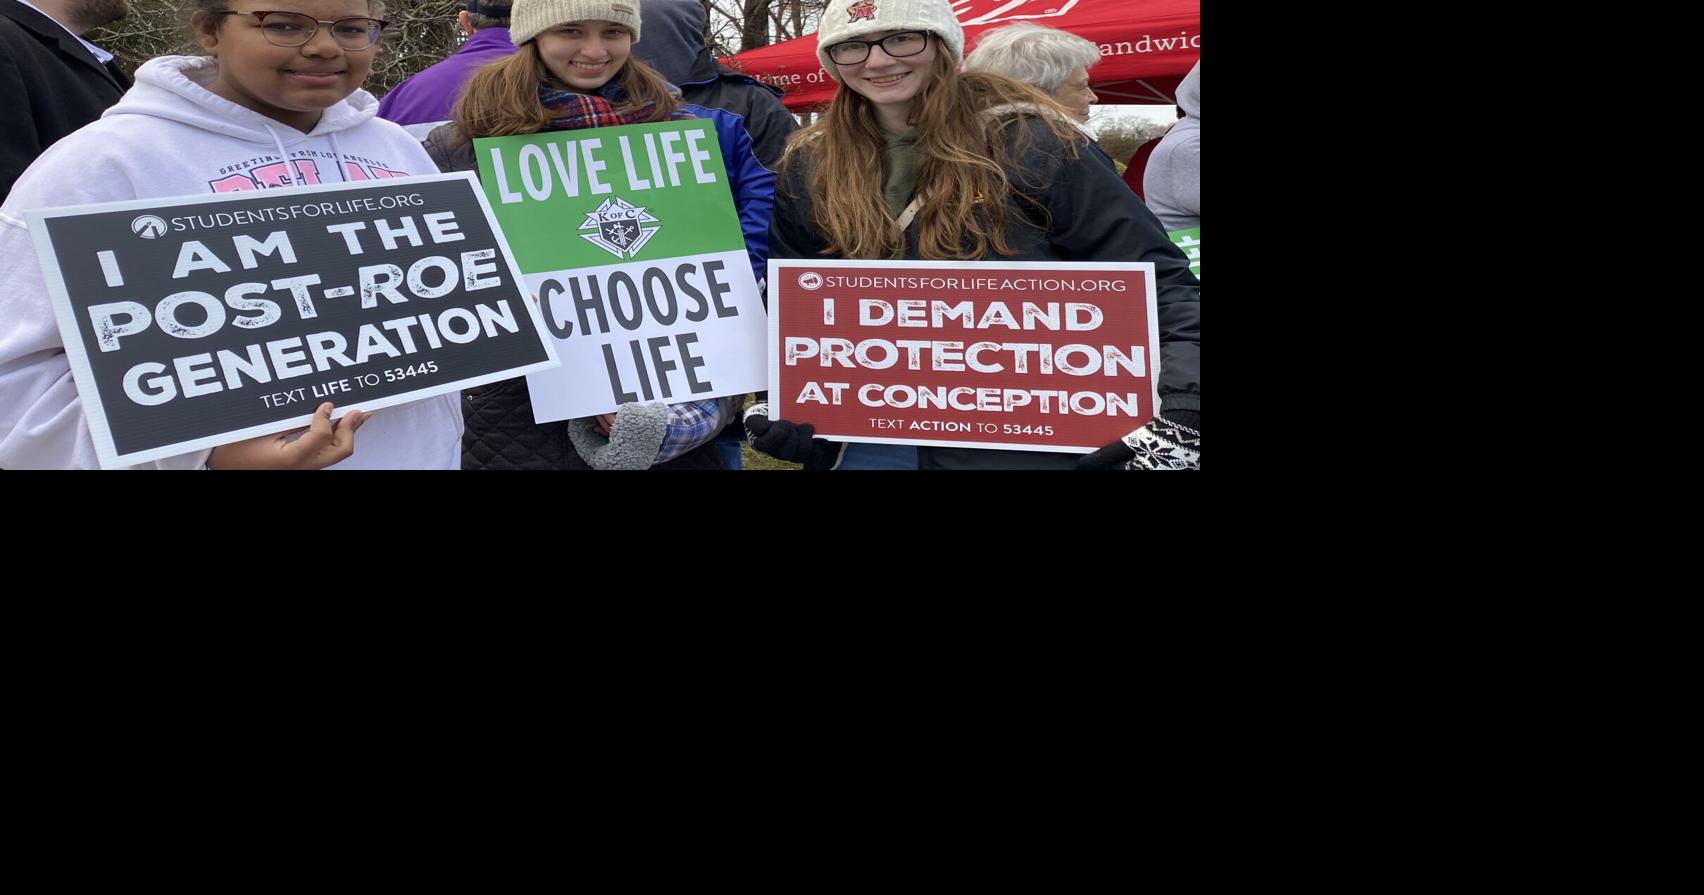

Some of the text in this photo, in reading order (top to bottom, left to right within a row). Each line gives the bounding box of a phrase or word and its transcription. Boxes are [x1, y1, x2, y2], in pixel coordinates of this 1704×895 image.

[806, 67, 825, 83] of
[219, 155, 281, 175] GREETIN
[490, 128, 717, 204] LOVE LIFE
[171, 193, 424, 232] STUDENTSFORLIFE.ORG
[625, 209, 636, 219] C
[96, 211, 465, 287] I AM THE
[88, 248, 501, 353] POST-ROE
[539, 260, 739, 339] CHOOSE
[823, 298, 1104, 331] I DEMAND
[122, 299, 519, 406] GENERATION
[601, 332, 713, 406] LIFE
[785, 336, 1146, 378] PROTECTION
[259, 361, 439, 409] TEXT LIFE TO 53445
[796, 381, 1139, 417] AT CONCEPTION
[869, 418, 1054, 436] TEXT ACTION TO 53445
